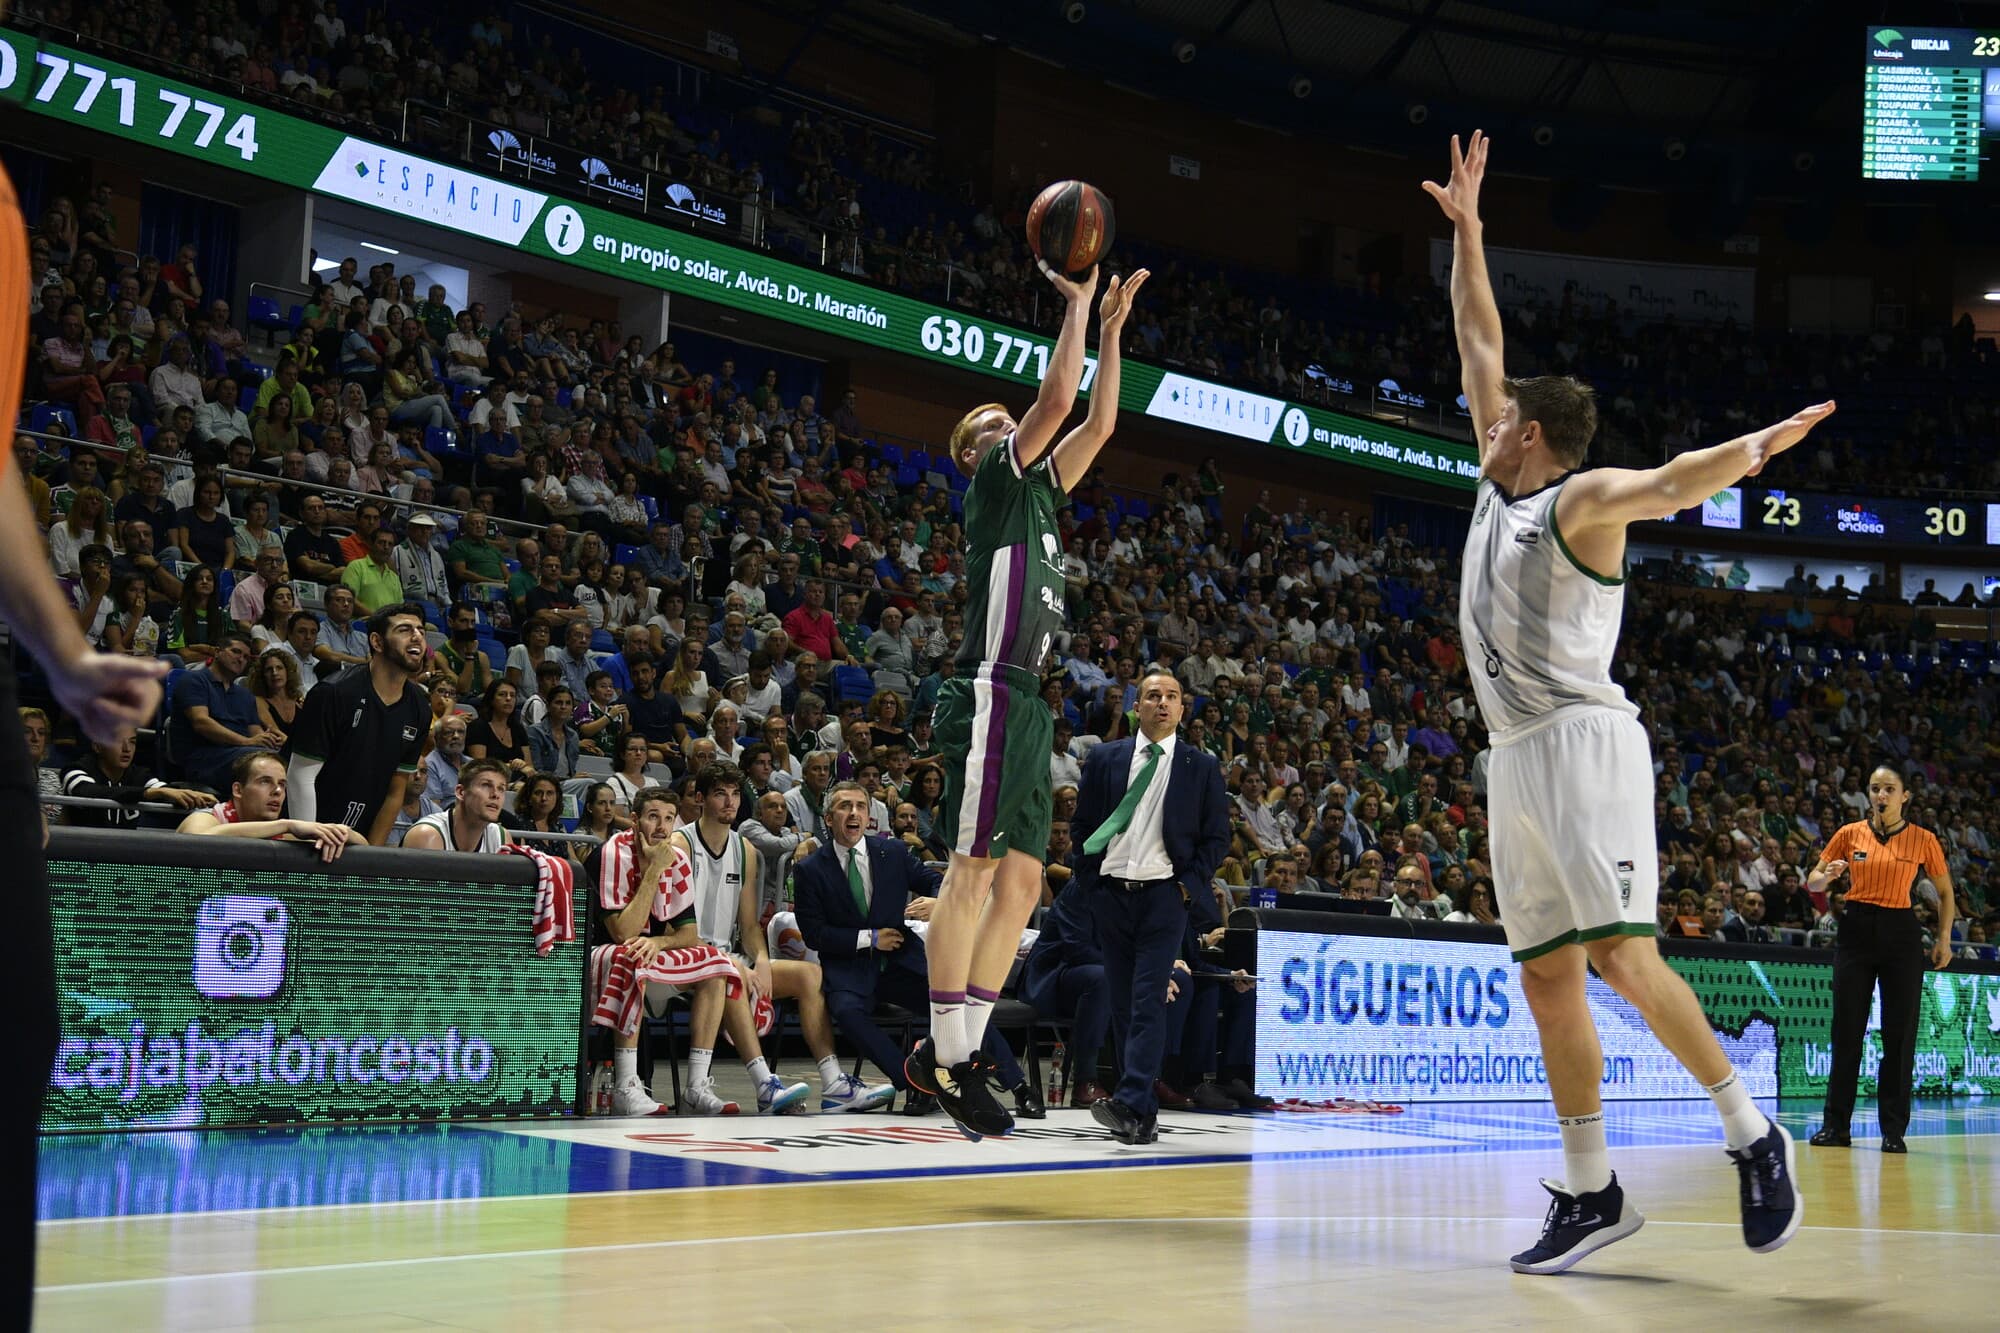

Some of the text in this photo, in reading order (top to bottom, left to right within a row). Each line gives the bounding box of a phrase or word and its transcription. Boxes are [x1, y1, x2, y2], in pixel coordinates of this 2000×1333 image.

[1911, 36, 2000, 56] UNICAJA 23
[35, 51, 136, 127] 771
[159, 88, 259, 161] 774
[378, 159, 521, 224] ESPACIO
[608, 176, 644, 197] Unicaja
[376, 192, 454, 218] MEDINA
[592, 233, 887, 329] en propio solar, Avda. Dr. Marañón
[920, 316, 984, 362] 630
[992, 332, 1049, 380] 771
[1184, 386, 1270, 425] ESPACIO
[1313, 426, 1328, 444] en
[1330, 430, 1370, 454] propio
[1370, 441, 1402, 463] solar,
[1403, 448, 1436, 470] Avda.
[1438, 456, 1454, 474] Dr.
[1762, 496, 1801, 527] 23
[1838, 508, 1860, 522] liga
[1838, 521, 1884, 534] endesa
[1924, 506, 1966, 536] 30
[1037, 632, 1050, 667] 9
[342, 800, 366, 828] 11
[1280, 935, 1510, 1029] SÍGUENOS
[1277, 1042, 1634, 1095] www.unicajabalonceom
